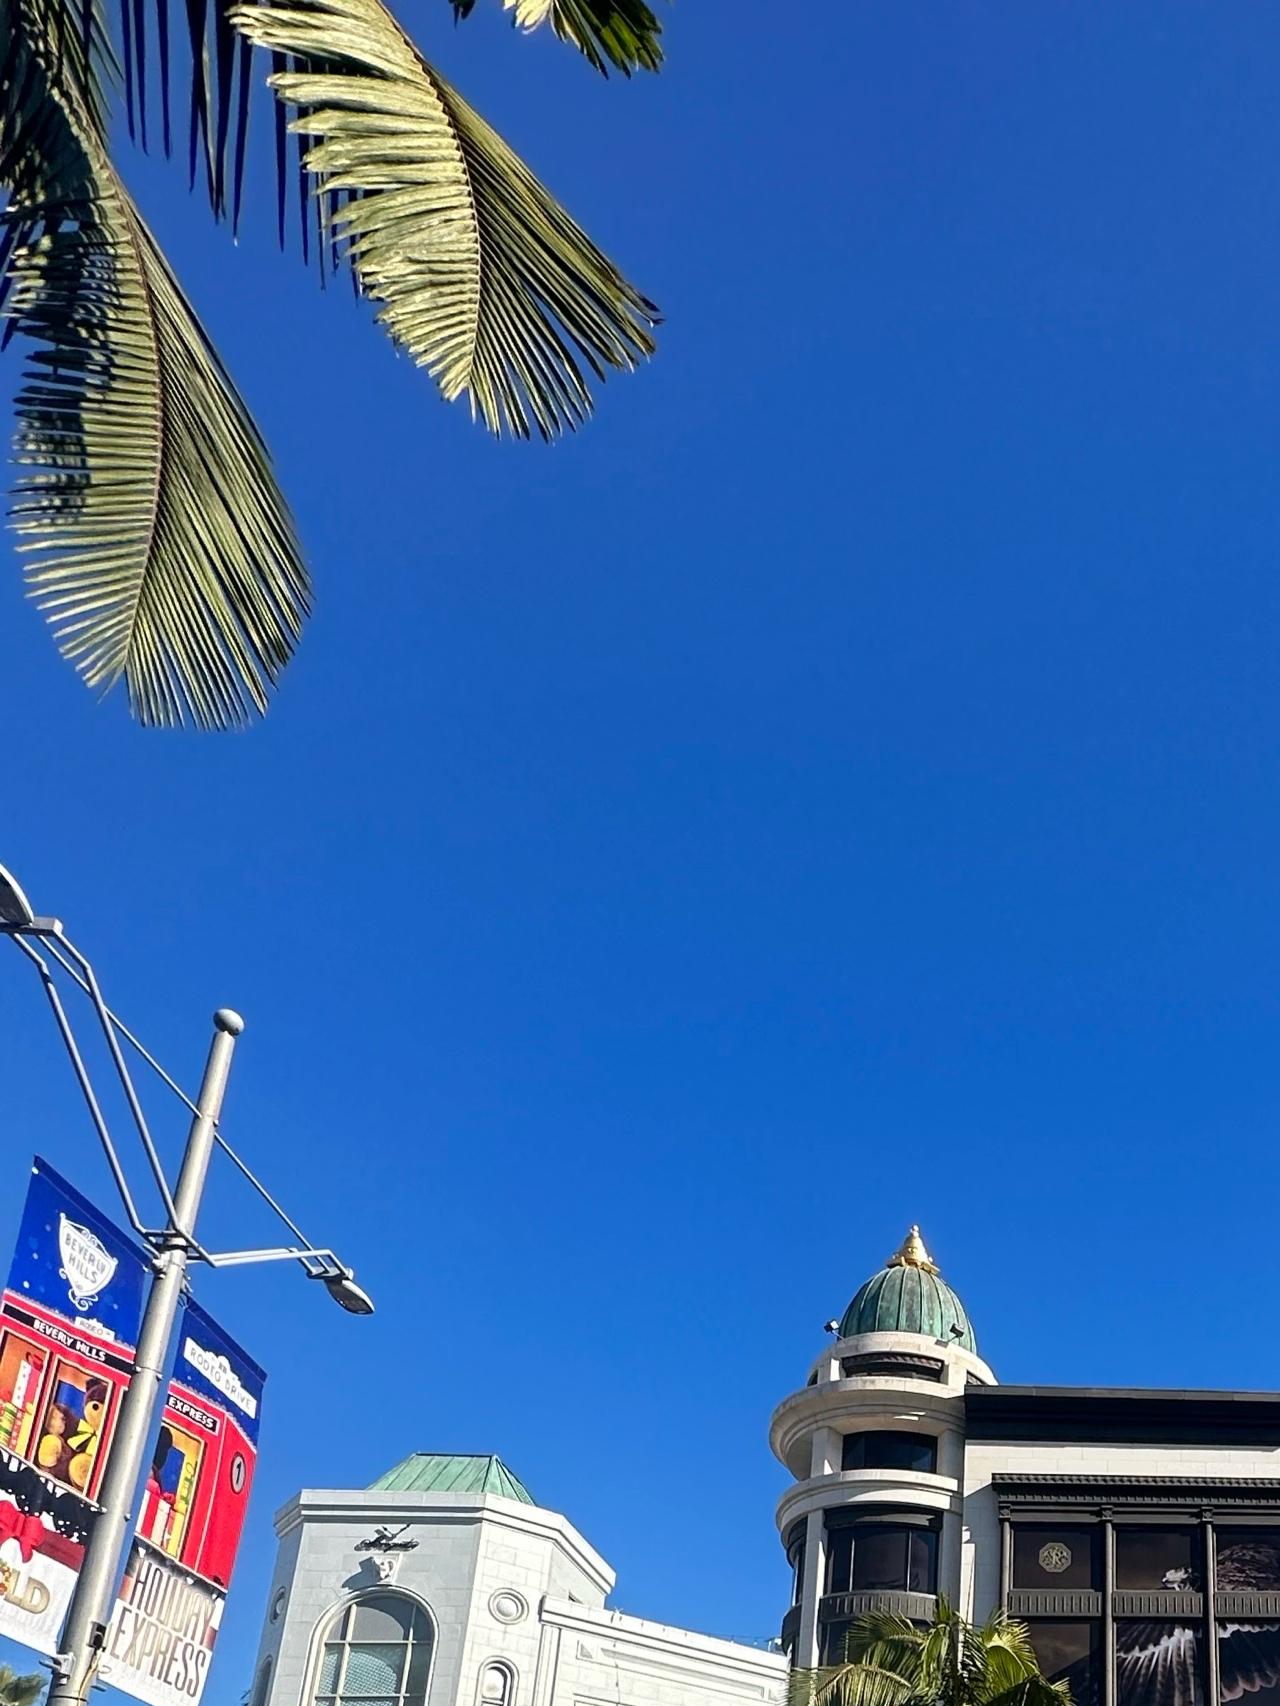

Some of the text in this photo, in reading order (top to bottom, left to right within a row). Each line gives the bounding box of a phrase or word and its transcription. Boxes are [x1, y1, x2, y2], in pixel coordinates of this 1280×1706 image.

[64, 1232, 107, 1275] BEVERLY
[68, 1253, 99, 1285] HILLS
[33, 1319, 107, 1362] BEVERLY HILLS
[189, 1346, 252, 1411] RODEO DRIVE
[168, 1396, 214, 1429] EXPRESS
[235, 1461, 242, 1485] 1
[130, 1557, 217, 1647] HOLIDAY
[110, 1605, 207, 1698] EXPRESS
